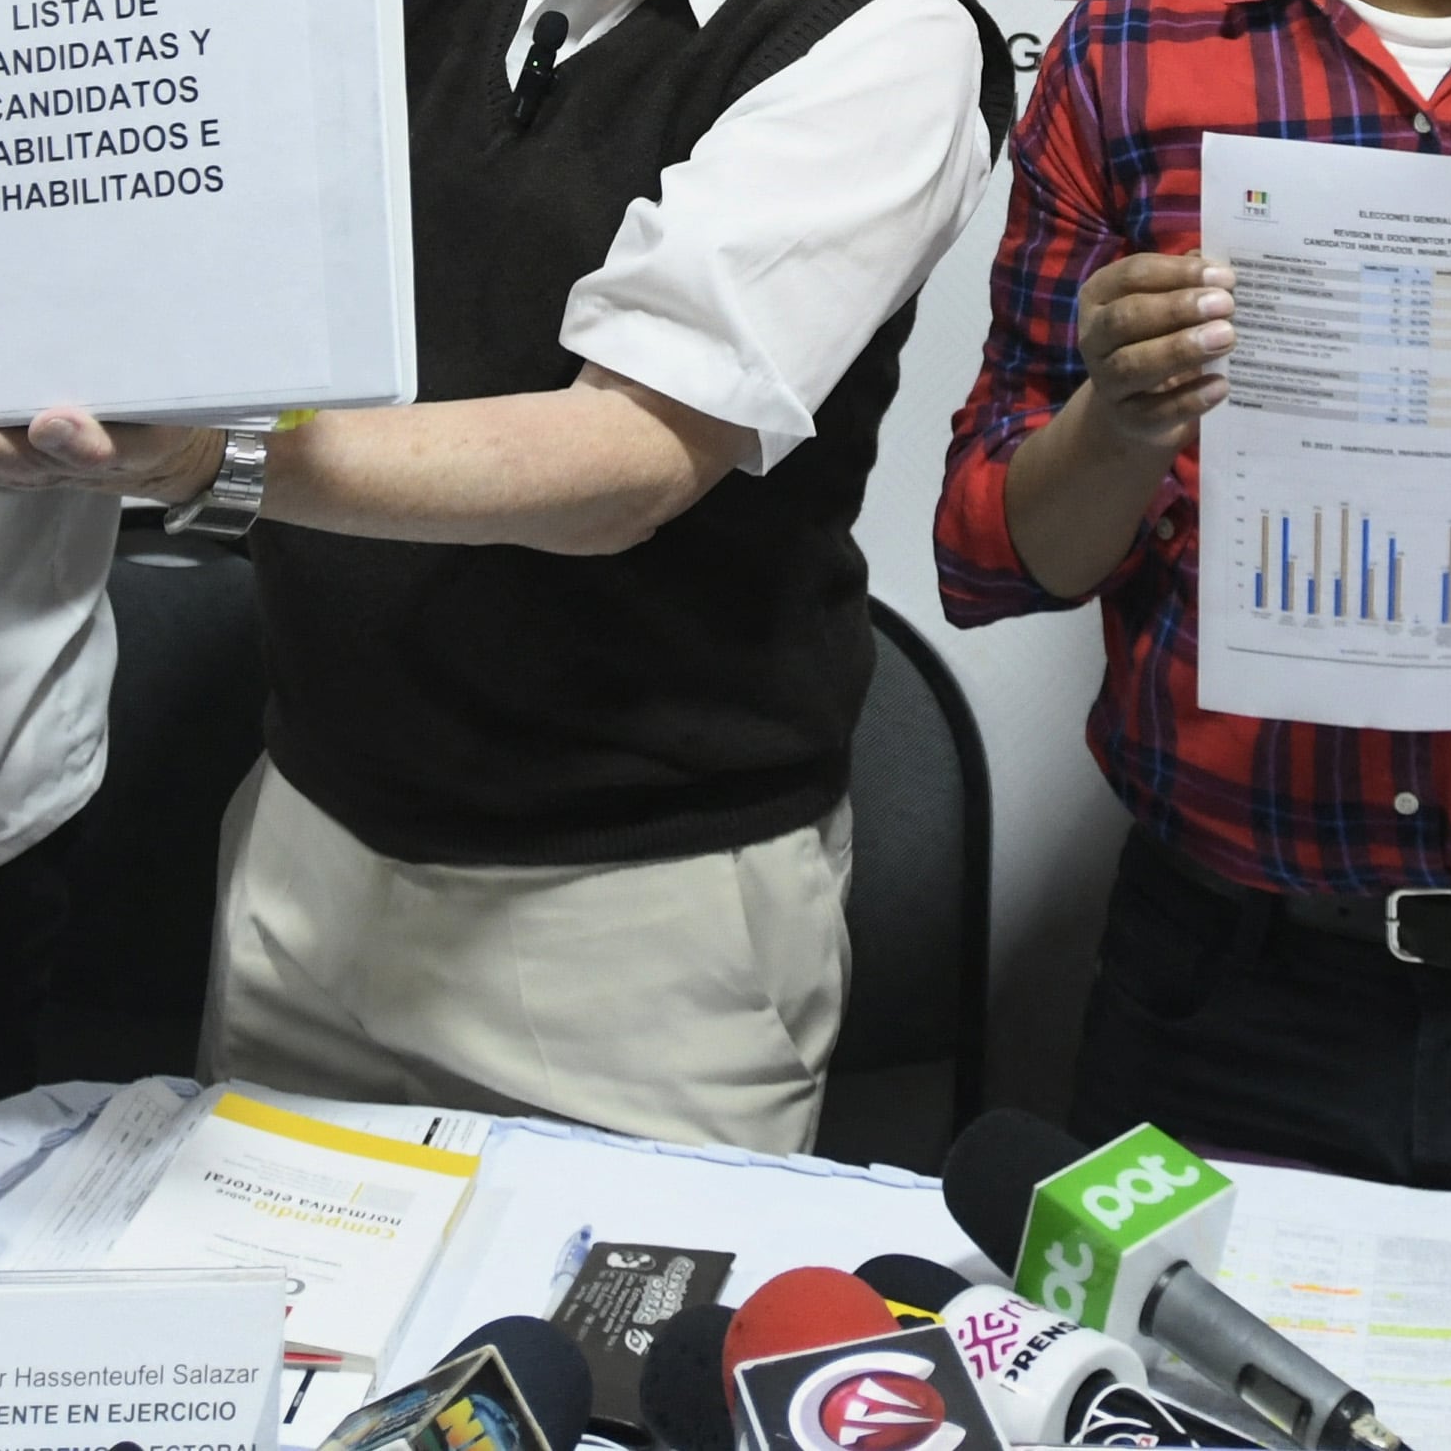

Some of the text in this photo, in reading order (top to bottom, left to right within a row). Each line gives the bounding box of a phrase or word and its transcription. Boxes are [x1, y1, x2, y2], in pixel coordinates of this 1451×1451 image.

[190, 28, 211, 56] Y
[200, 119, 221, 147] E
[204, 1170, 293, 1203] electoral
[254, 1200, 397, 1240] compendio
[298, 1196, 402, 1227] normativa
[14, 1364, 165, 1388] Hassenteufel
[173, 1363, 260, 1385] Salazar
[68, 1404, 99, 1424] EN
[108, 1401, 237, 1424] EJERCICIO
